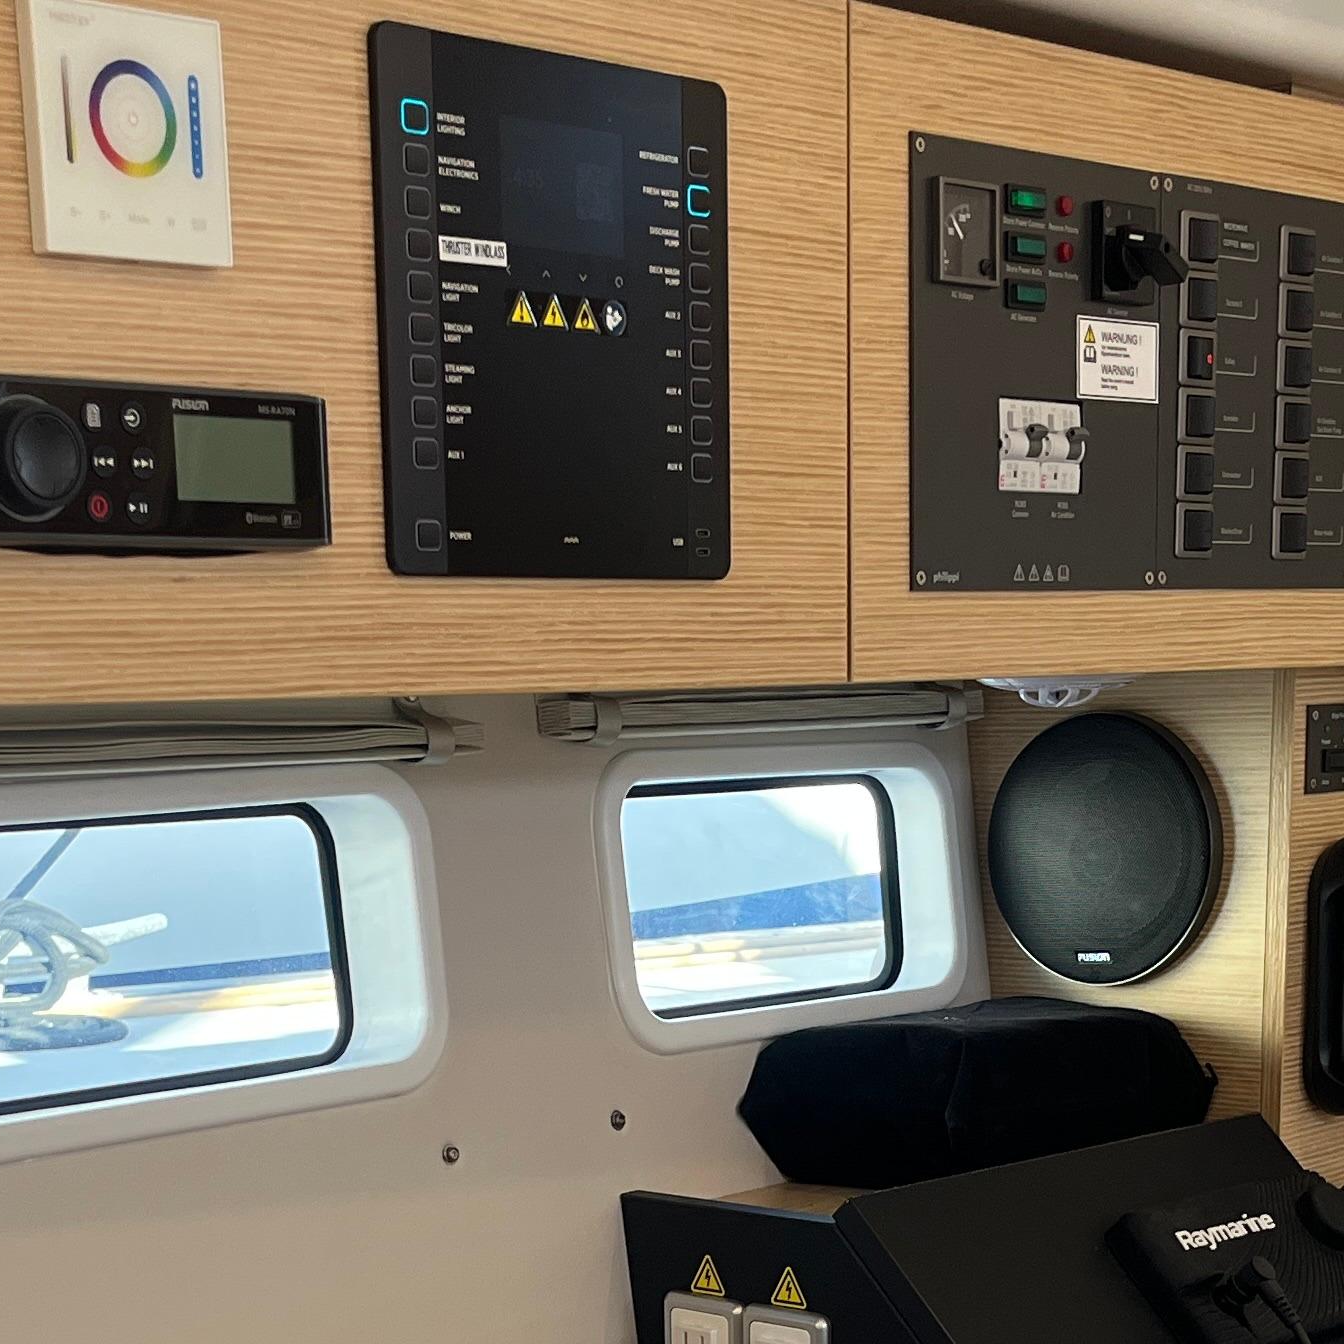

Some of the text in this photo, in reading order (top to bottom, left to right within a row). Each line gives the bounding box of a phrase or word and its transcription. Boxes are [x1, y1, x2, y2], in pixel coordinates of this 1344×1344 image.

[436, 112, 465, 125] INTERIOR
[437, 123, 466, 136] LIGHTING
[441, 281, 479, 294] NAVIGATION
[1101, 364, 1135, 377] WARNING
[449, 530, 472, 541] POWER
[1174, 1213, 1276, 1251] Raymarine
